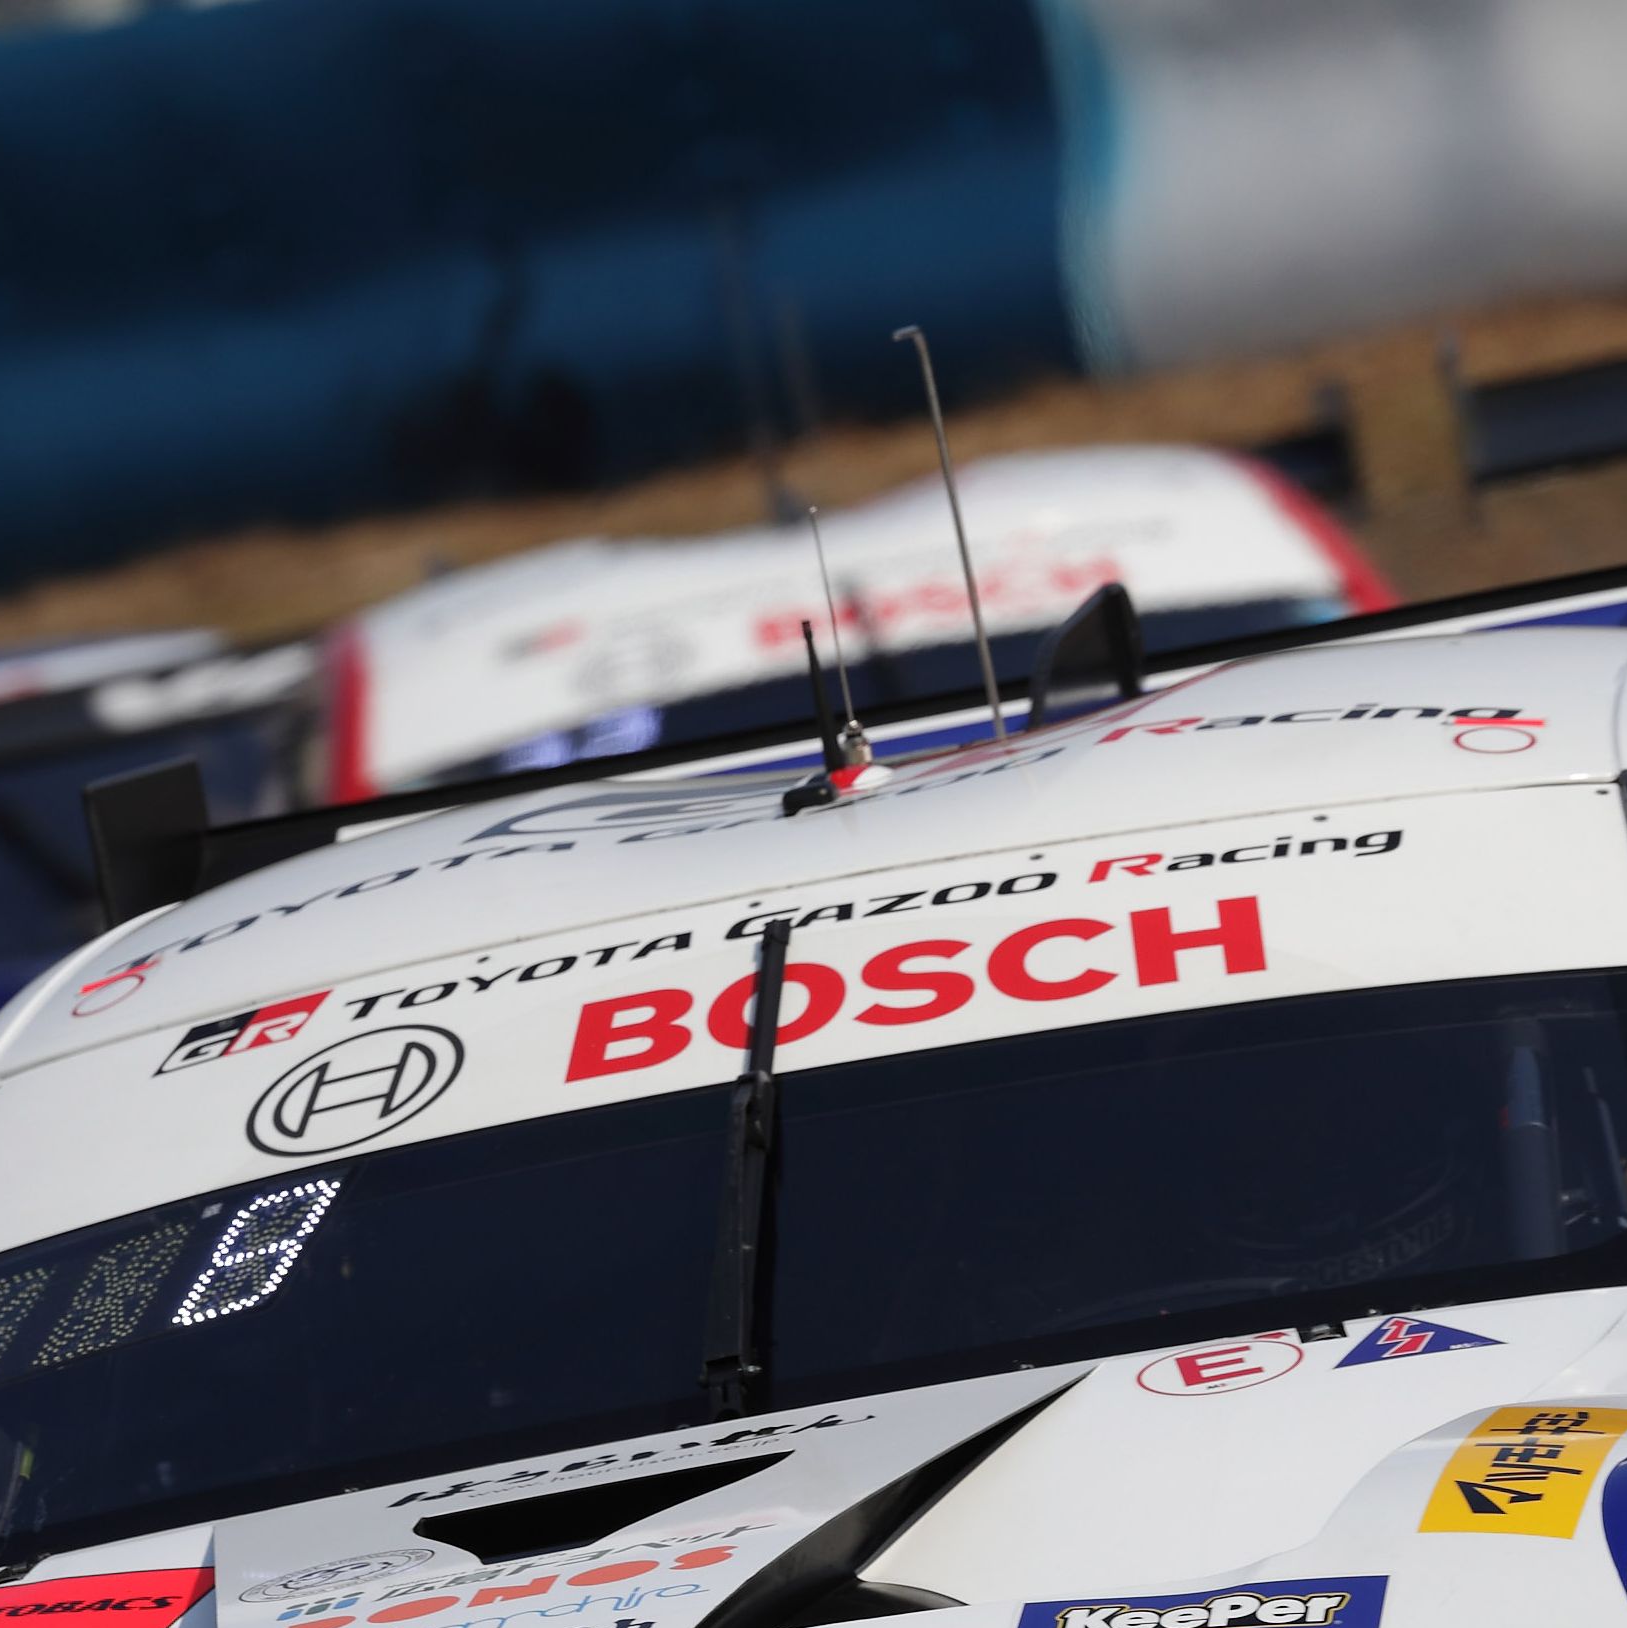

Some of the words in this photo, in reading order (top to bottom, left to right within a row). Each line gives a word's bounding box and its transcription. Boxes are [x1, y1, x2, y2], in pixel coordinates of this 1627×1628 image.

[345, 932, 694, 1020] TOYOTA
[724, 870, 1058, 942] GAZOO
[1088, 828, 1404, 884] Racing
[564, 894, 1268, 1084] BOSCH
[1176, 1346, 1264, 1387] E
